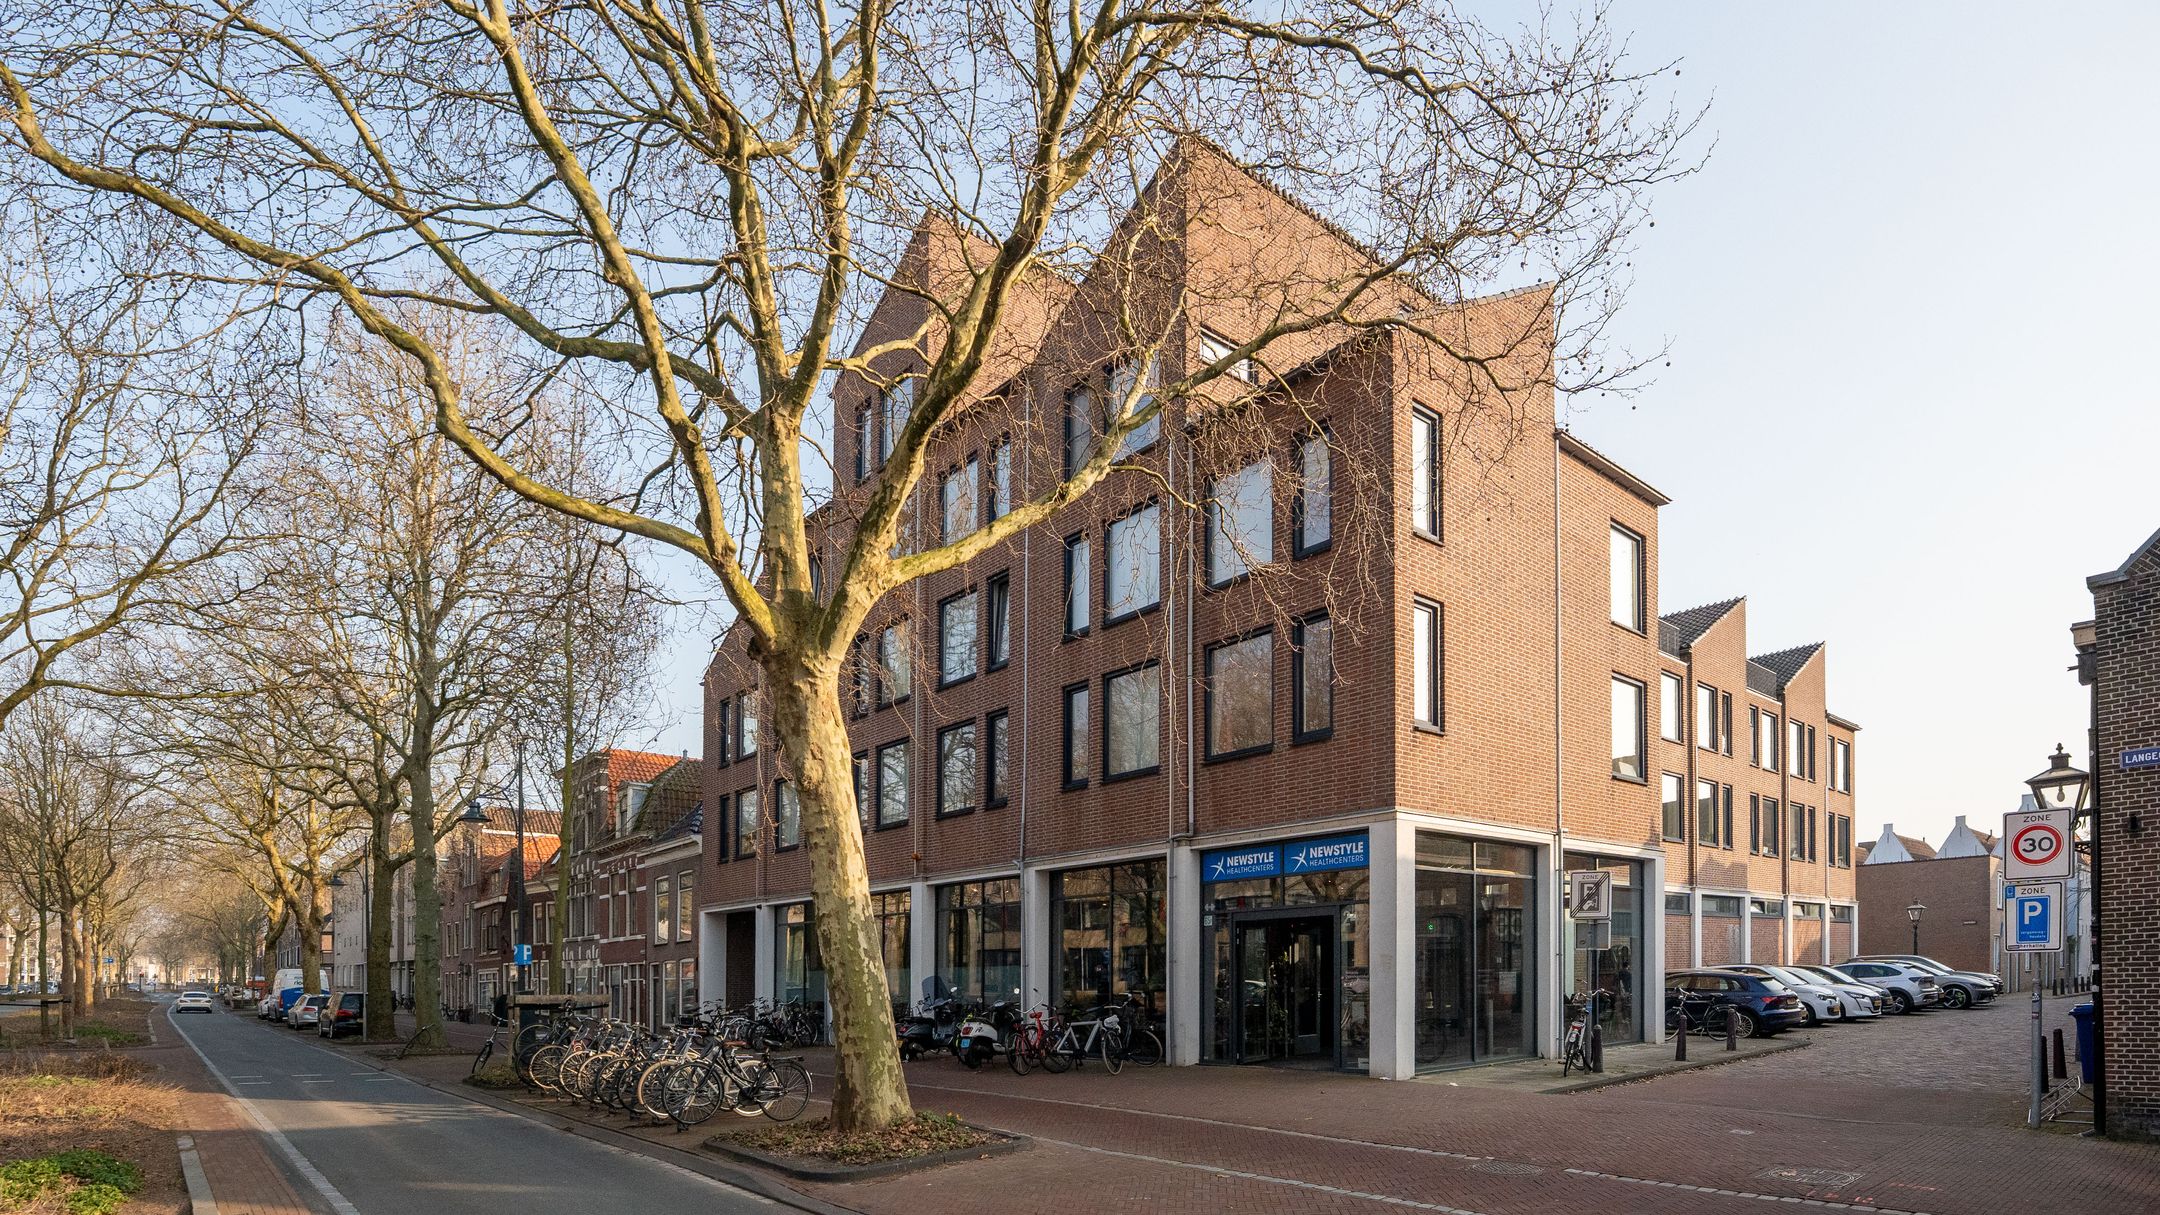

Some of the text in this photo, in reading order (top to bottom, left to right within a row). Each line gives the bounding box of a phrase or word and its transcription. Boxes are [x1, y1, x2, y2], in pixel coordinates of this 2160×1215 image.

[2125, 752, 2160, 764] LANGE
[2023, 814, 2051, 823] ZONE
[1309, 842, 1364, 858] NEWSTYLE
[2022, 836, 2054, 853] 30
[1226, 852, 1274, 867] NEWSTYLE
[1309, 854, 1364, 867] HEALTHCENTERS
[1226, 864, 1274, 875] HEALTHCENTERS
[2020, 887, 2046, 895] ZONE
[2024, 901, 2042, 925] P
[523, 944, 532, 960] P
